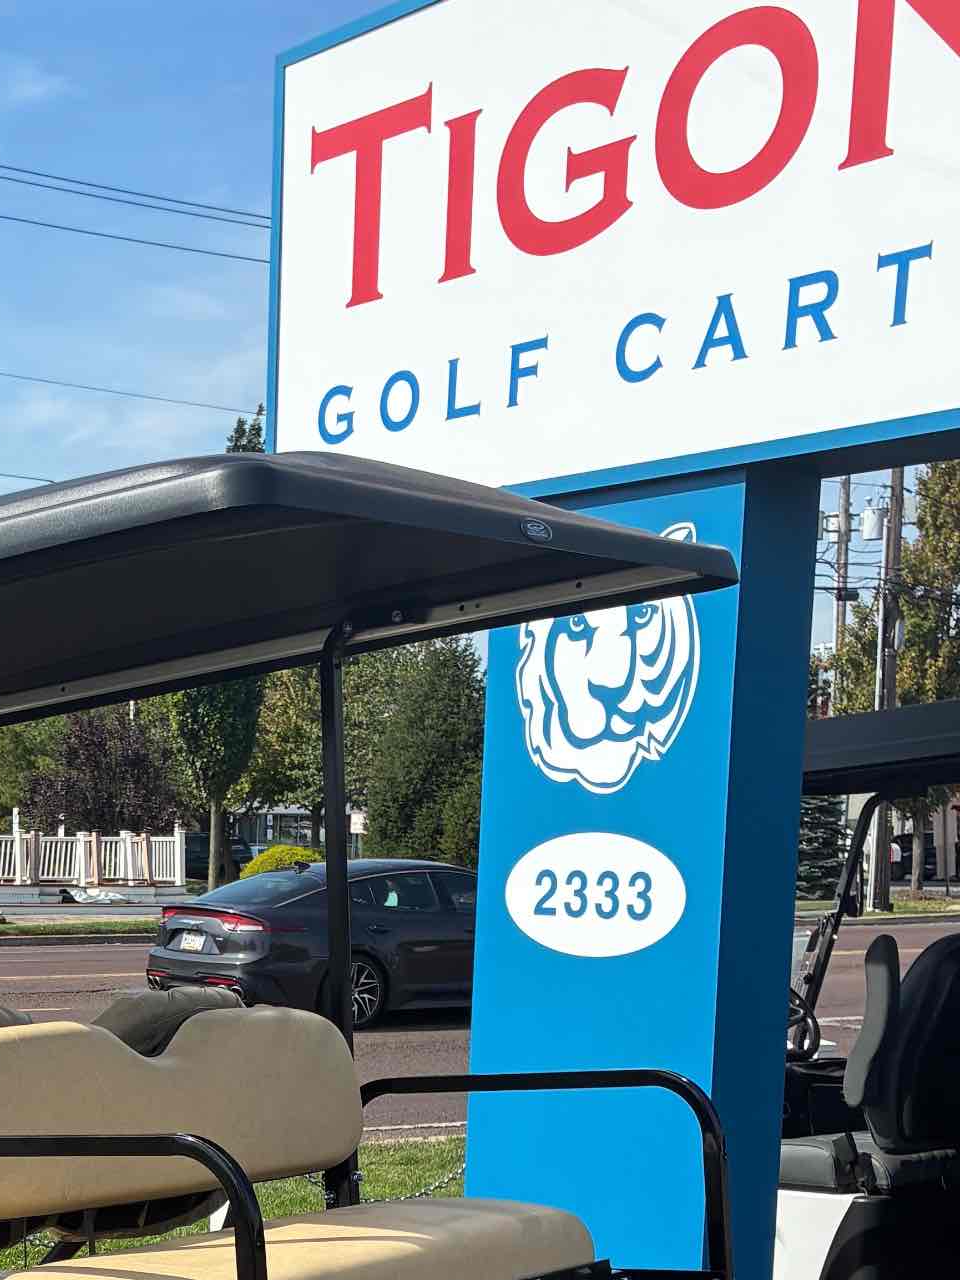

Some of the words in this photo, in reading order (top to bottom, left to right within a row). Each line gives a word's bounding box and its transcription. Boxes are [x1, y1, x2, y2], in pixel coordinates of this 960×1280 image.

[318, 336, 549, 445] GOLF
[614, 241, 934, 384] CART
[533, 869, 653, 921] 2333
